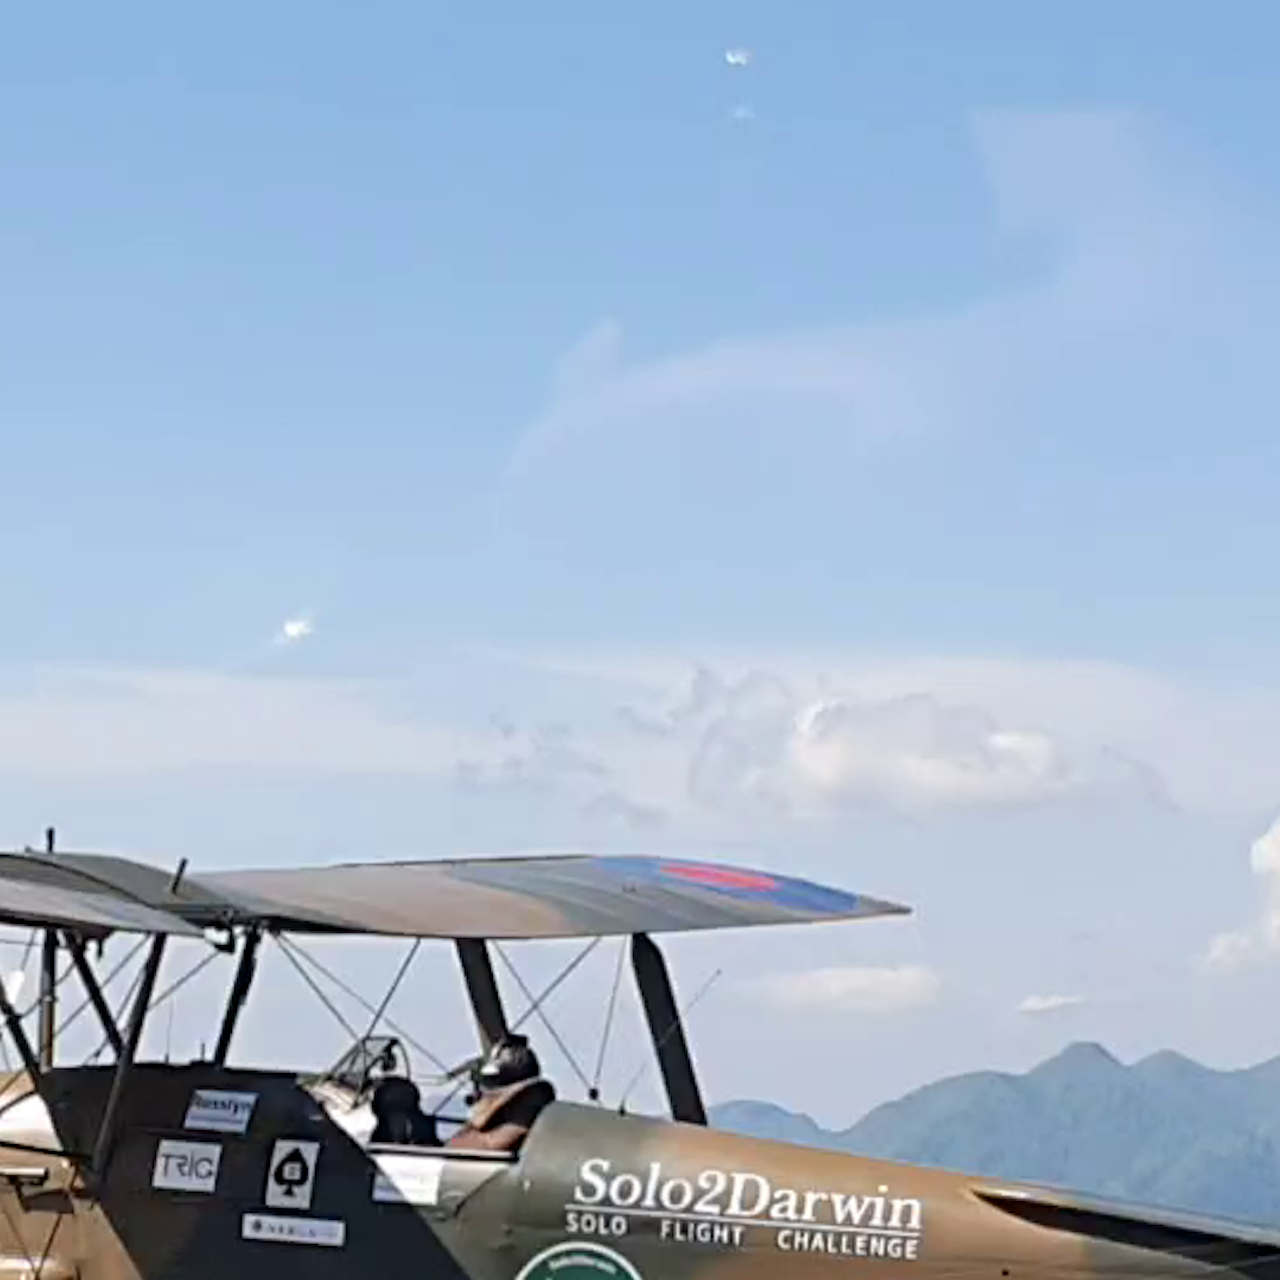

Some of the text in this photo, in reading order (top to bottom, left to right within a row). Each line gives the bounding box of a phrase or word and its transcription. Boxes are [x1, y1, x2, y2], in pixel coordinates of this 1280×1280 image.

[161, 1150, 214, 1179] TRIG
[574, 1157, 924, 1230] Solo2Darwin
[565, 1212, 919, 1260] SOLO FLIGHT CHALLENGE
